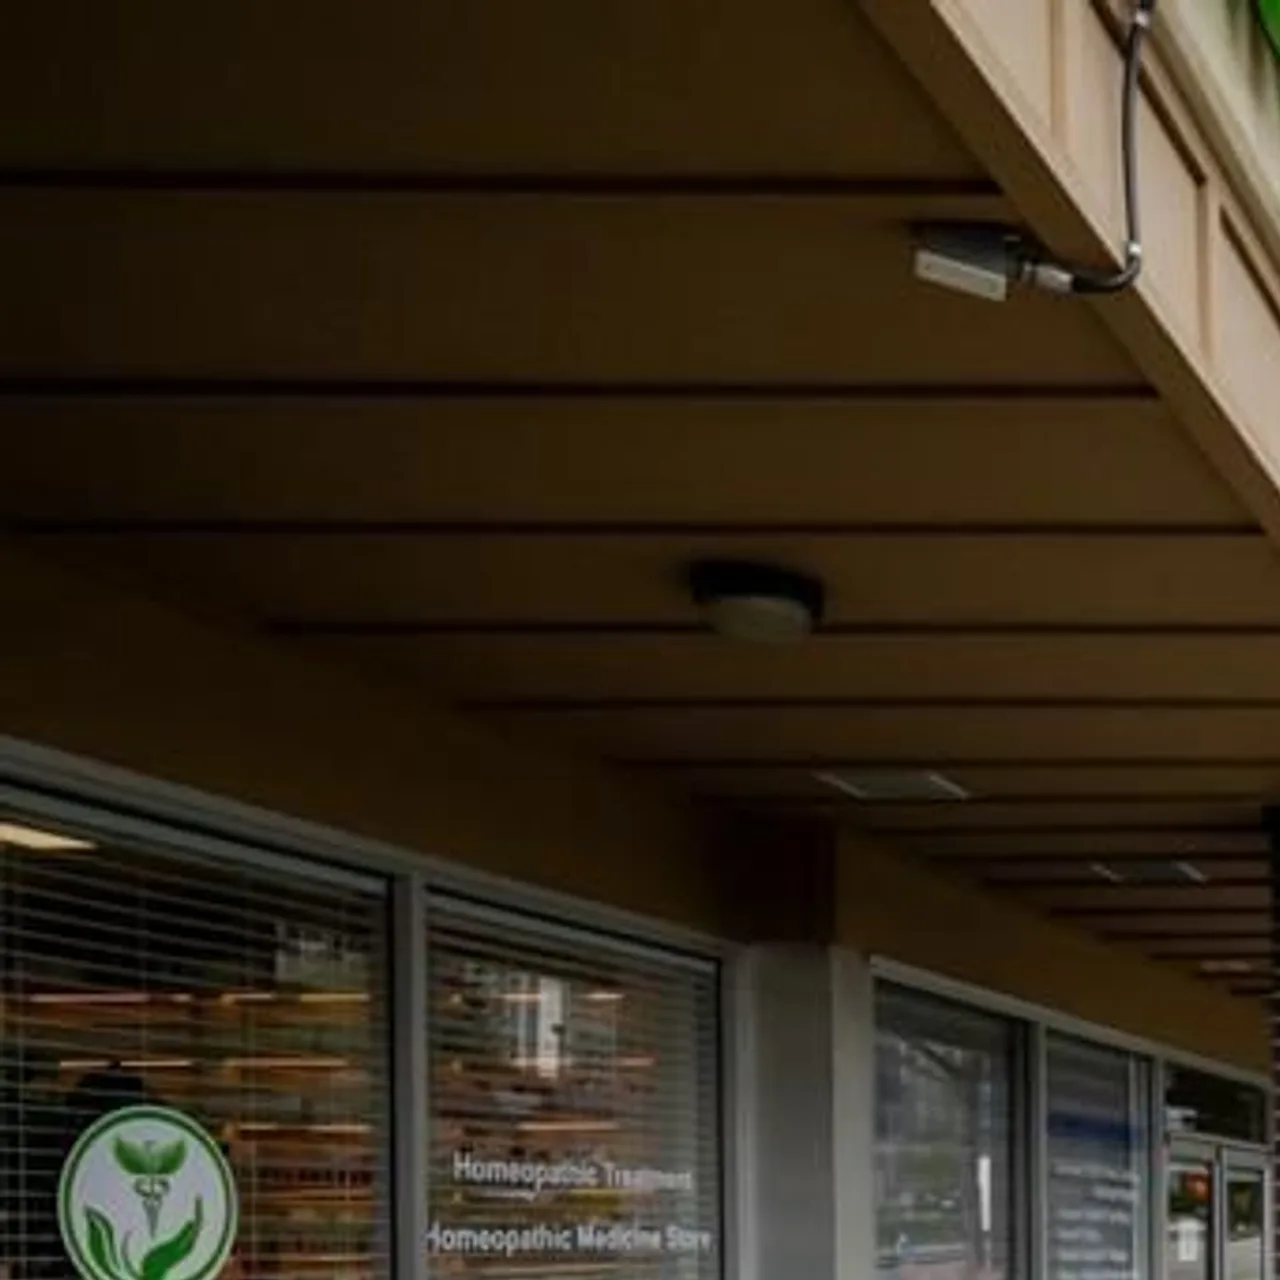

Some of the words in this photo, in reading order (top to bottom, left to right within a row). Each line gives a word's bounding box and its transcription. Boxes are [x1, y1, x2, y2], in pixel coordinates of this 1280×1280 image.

[453, 1152, 597, 1191] Homeopathic
[427, 1211, 571, 1257] Homeopathic
[577, 1217, 661, 1251] Medicine
